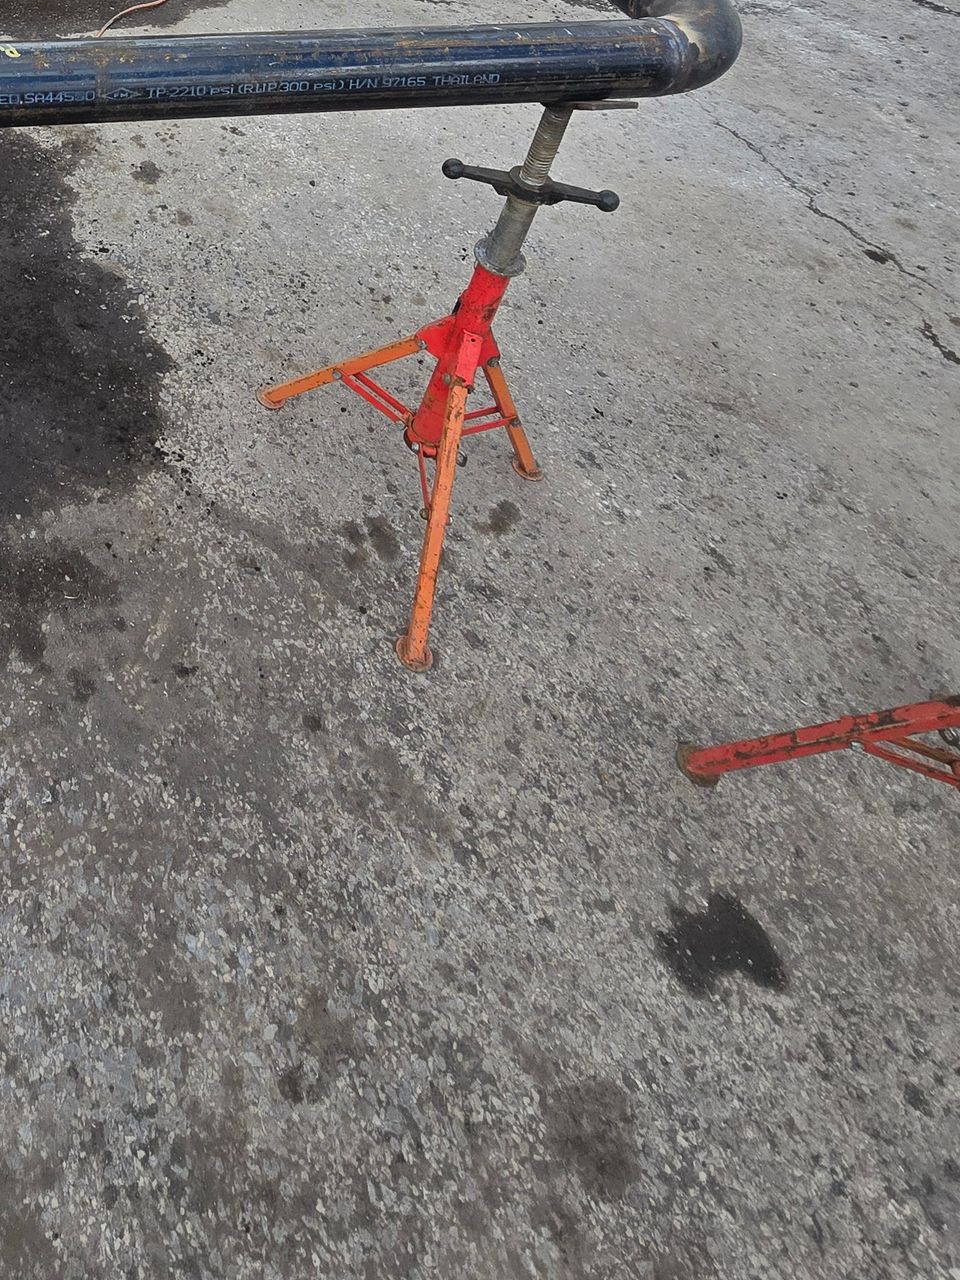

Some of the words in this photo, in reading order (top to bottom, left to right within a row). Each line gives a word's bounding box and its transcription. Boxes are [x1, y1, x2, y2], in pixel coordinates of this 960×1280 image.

[348, 79, 378, 90] H/N
[382, 76, 427, 88] 97165
[431, 73, 501, 86] THAILAND
